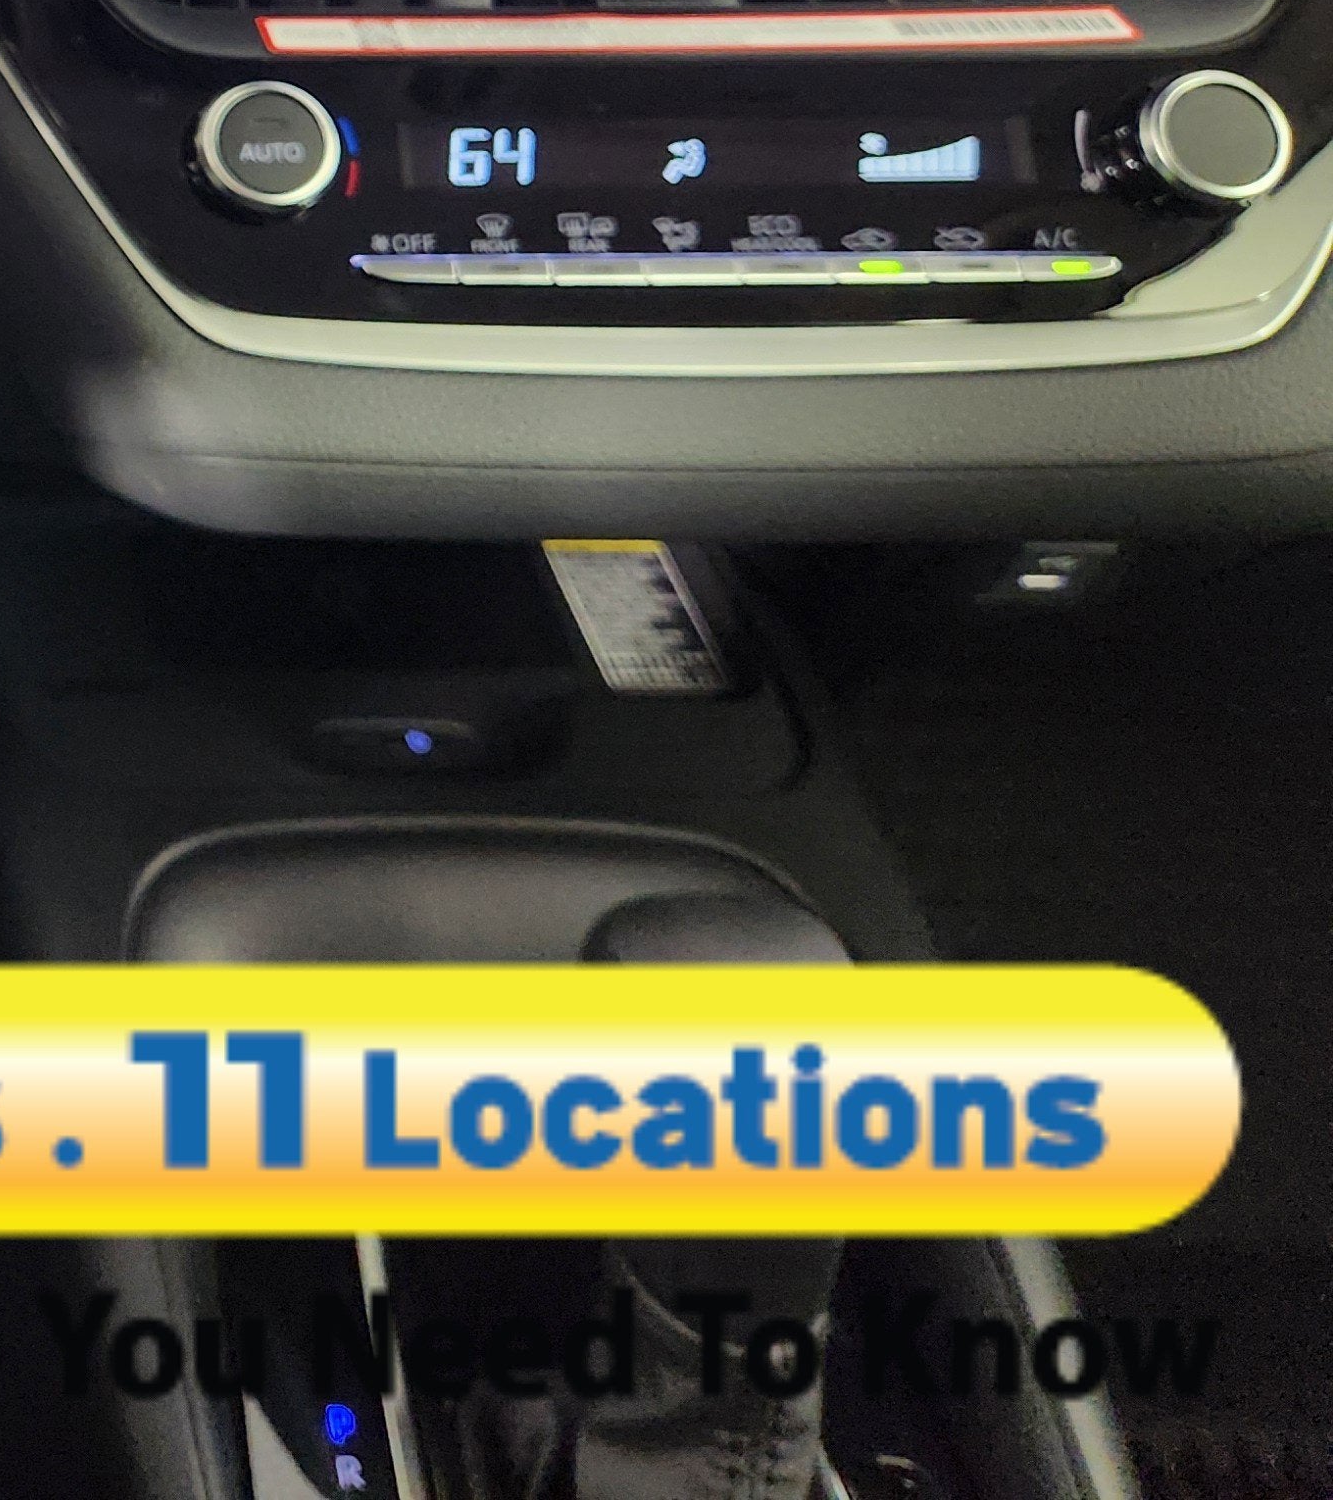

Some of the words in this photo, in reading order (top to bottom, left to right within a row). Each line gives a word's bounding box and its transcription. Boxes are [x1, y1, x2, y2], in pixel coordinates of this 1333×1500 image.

[239, 141, 307, 164] AUTO
[448, 127, 538, 187] 64
[391, 232, 437, 255] OFF
[1034, 227, 1079, 250] A/C
[335, 1454, 367, 1491] R
